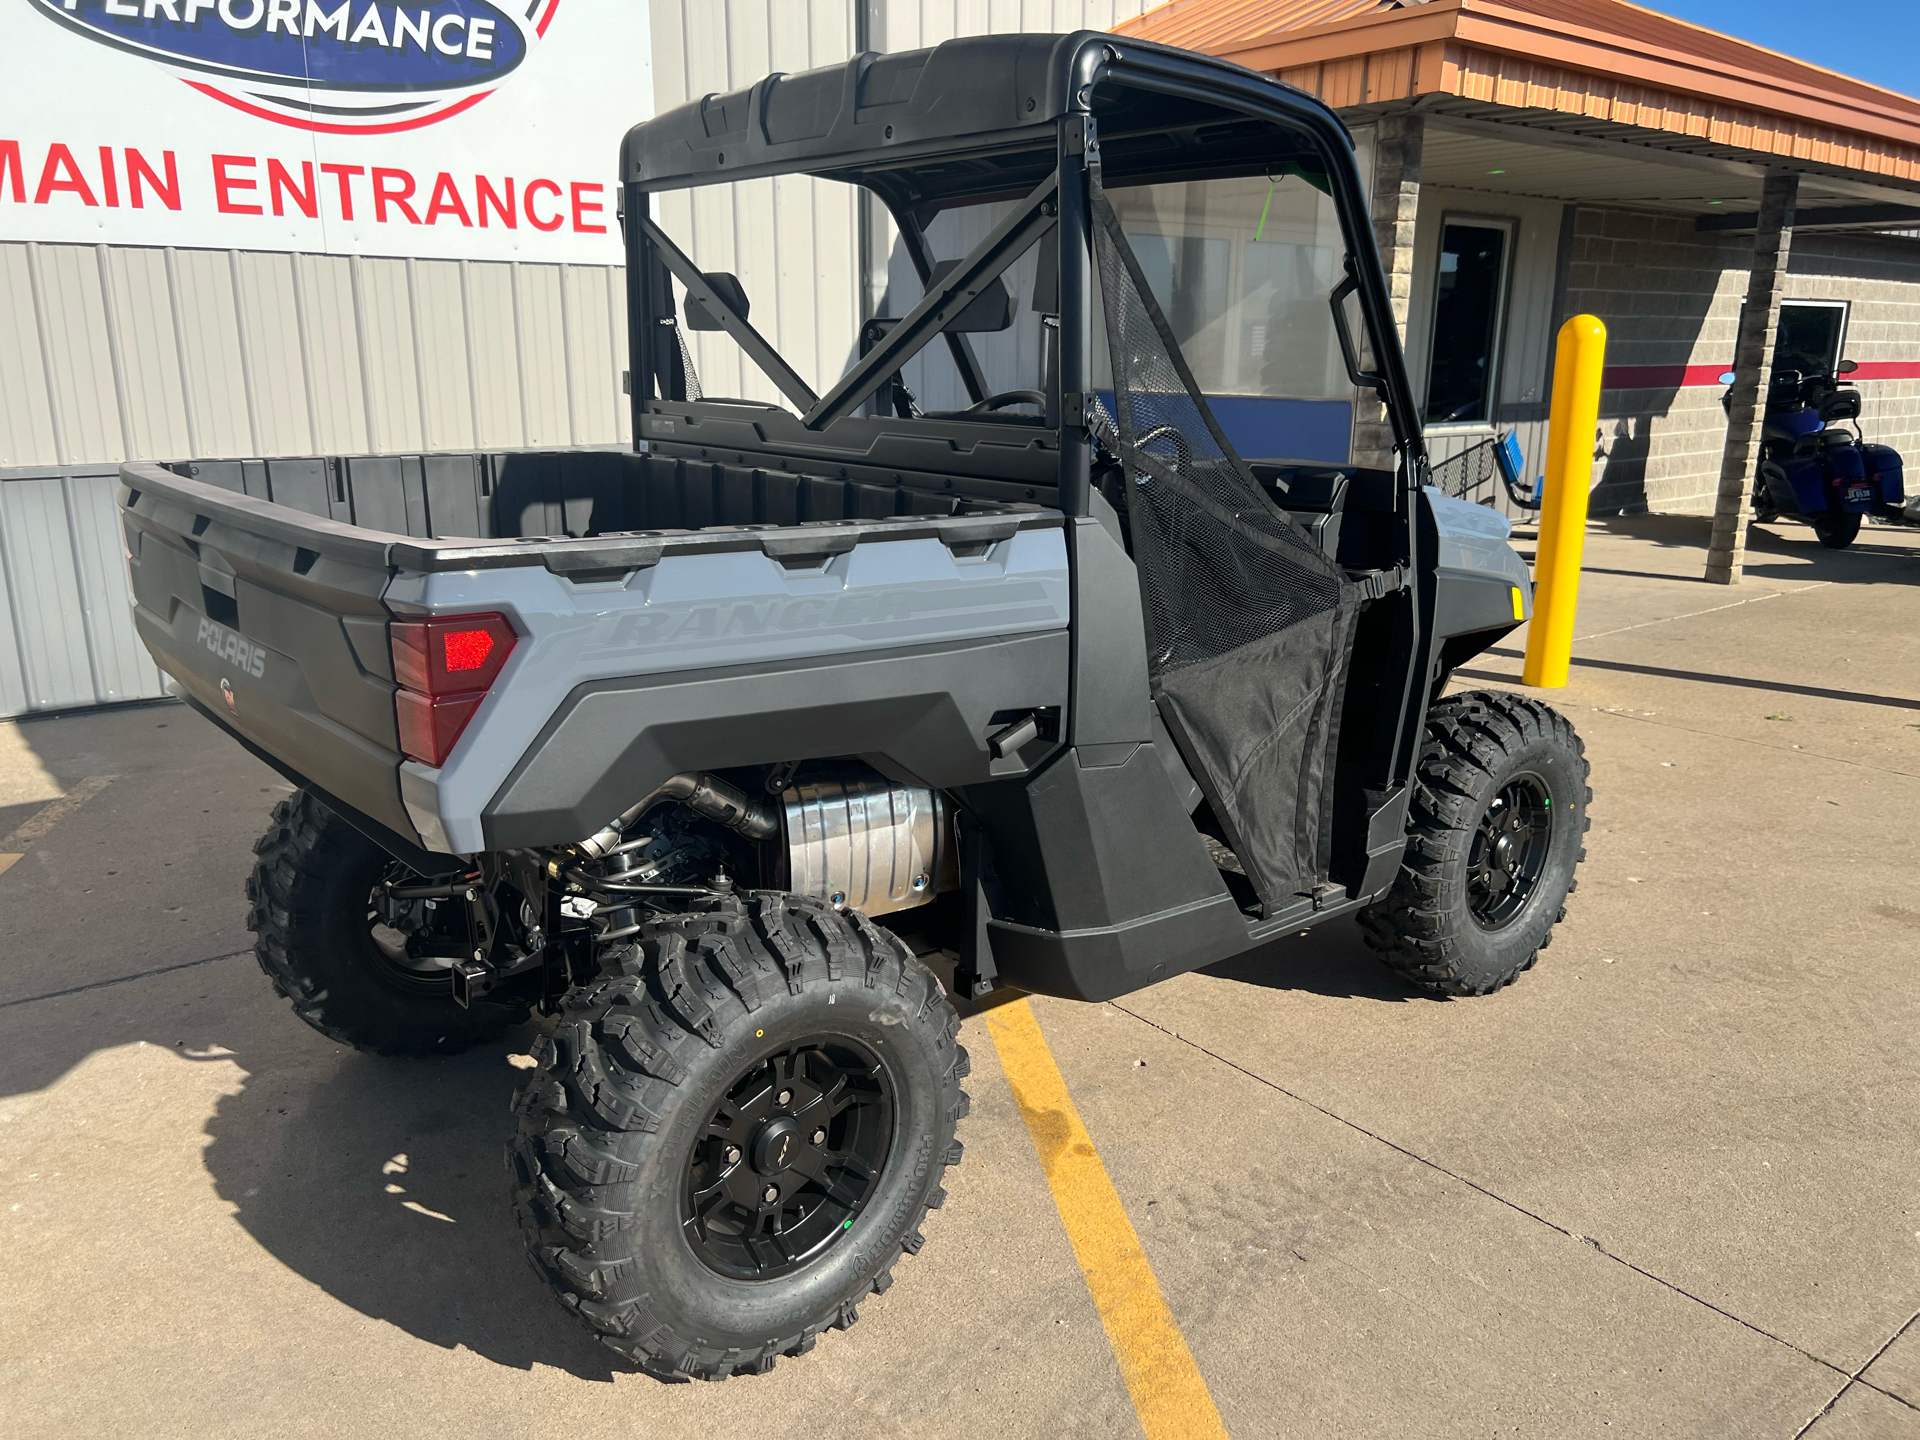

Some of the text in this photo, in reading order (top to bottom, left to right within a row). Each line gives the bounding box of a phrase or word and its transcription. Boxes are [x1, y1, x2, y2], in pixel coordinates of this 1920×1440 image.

[63, 0, 496, 60] FORMANCE
[211, 153, 607, 234] ENTRANCE
[197, 617, 266, 678] POLARIS
[603, 590, 911, 648] RANGER
